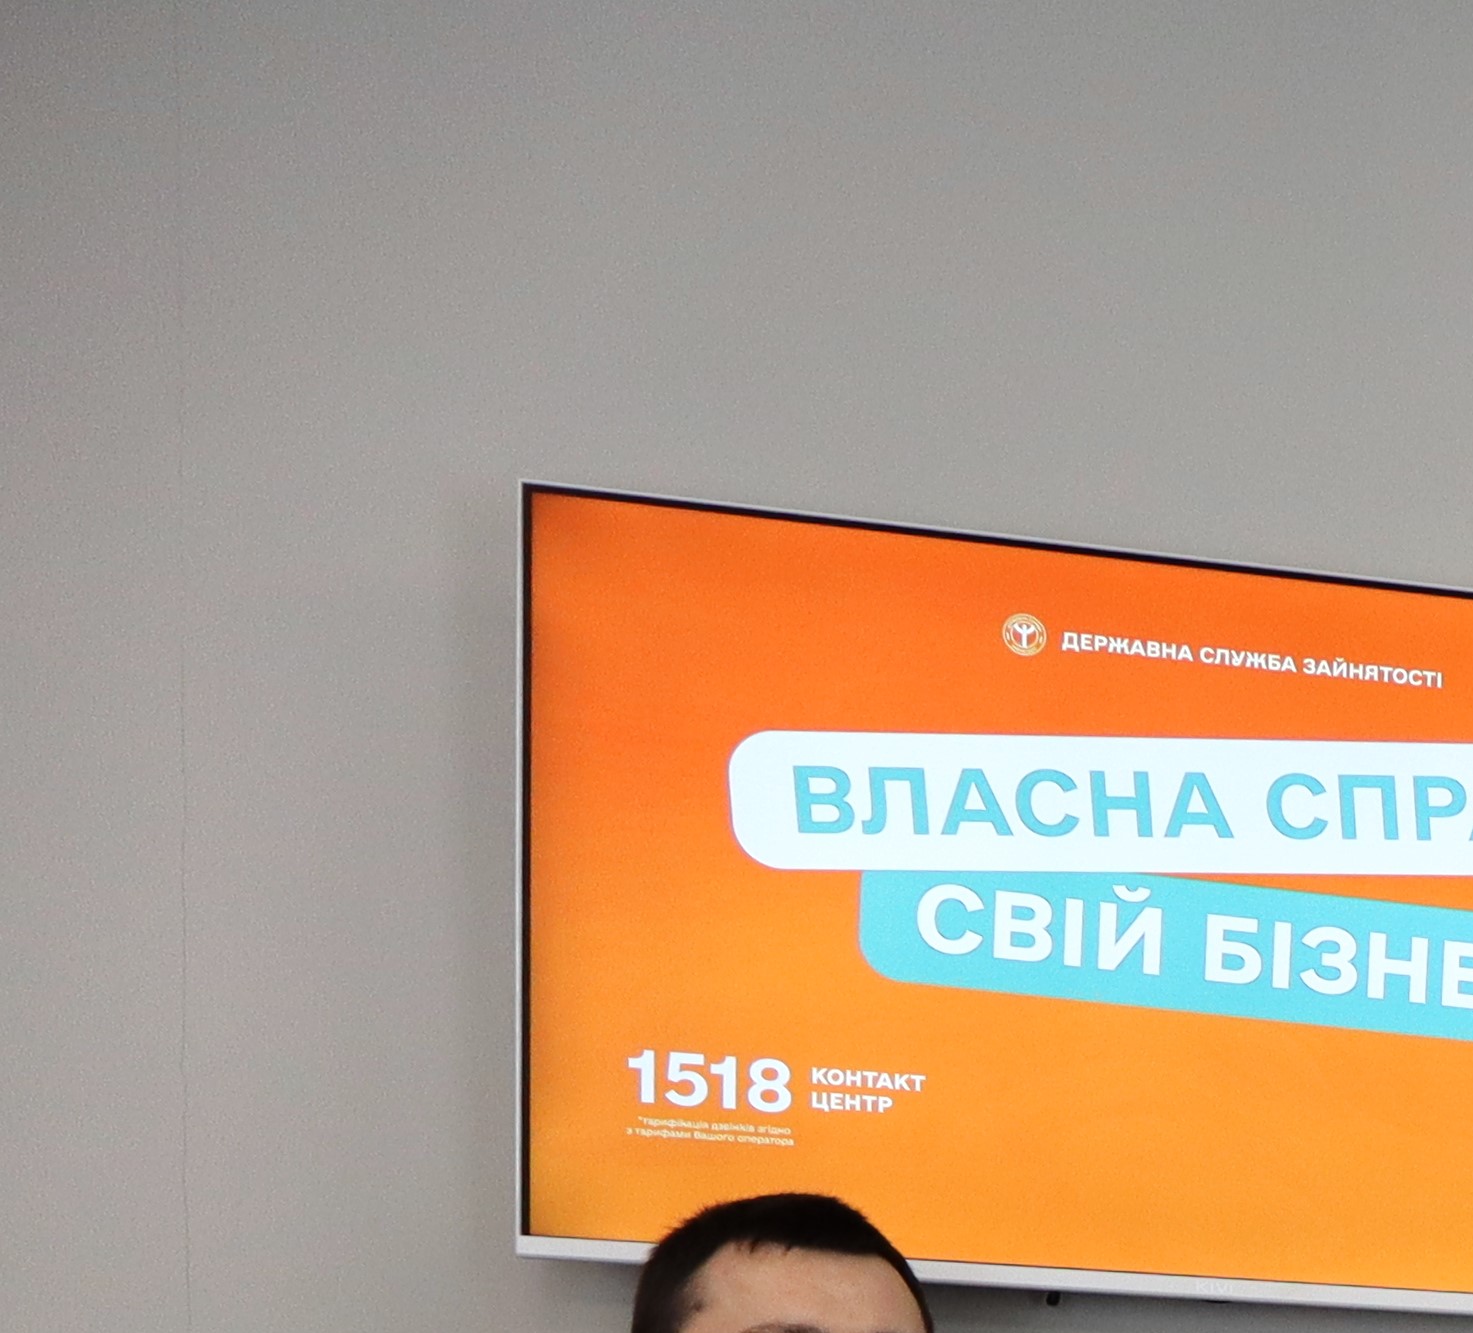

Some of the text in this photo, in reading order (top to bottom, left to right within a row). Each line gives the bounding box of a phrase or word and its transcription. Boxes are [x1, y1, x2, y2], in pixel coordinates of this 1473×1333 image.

[1061, 631, 1194, 662] ДЕРЖАВНА
[1199, 646, 1298, 673] СЛУЖБА
[1302, 657, 1443, 689] ЗАЙНЯТОСТІ
[792, 764, 1234, 839] ВЛАСНА
[916, 883, 1163, 976] СВІЙ
[625, 1048, 793, 1115] 1518
[809, 1066, 927, 1093] КОНТАКТ
[809, 1090, 894, 1114] ЦЕНТР
